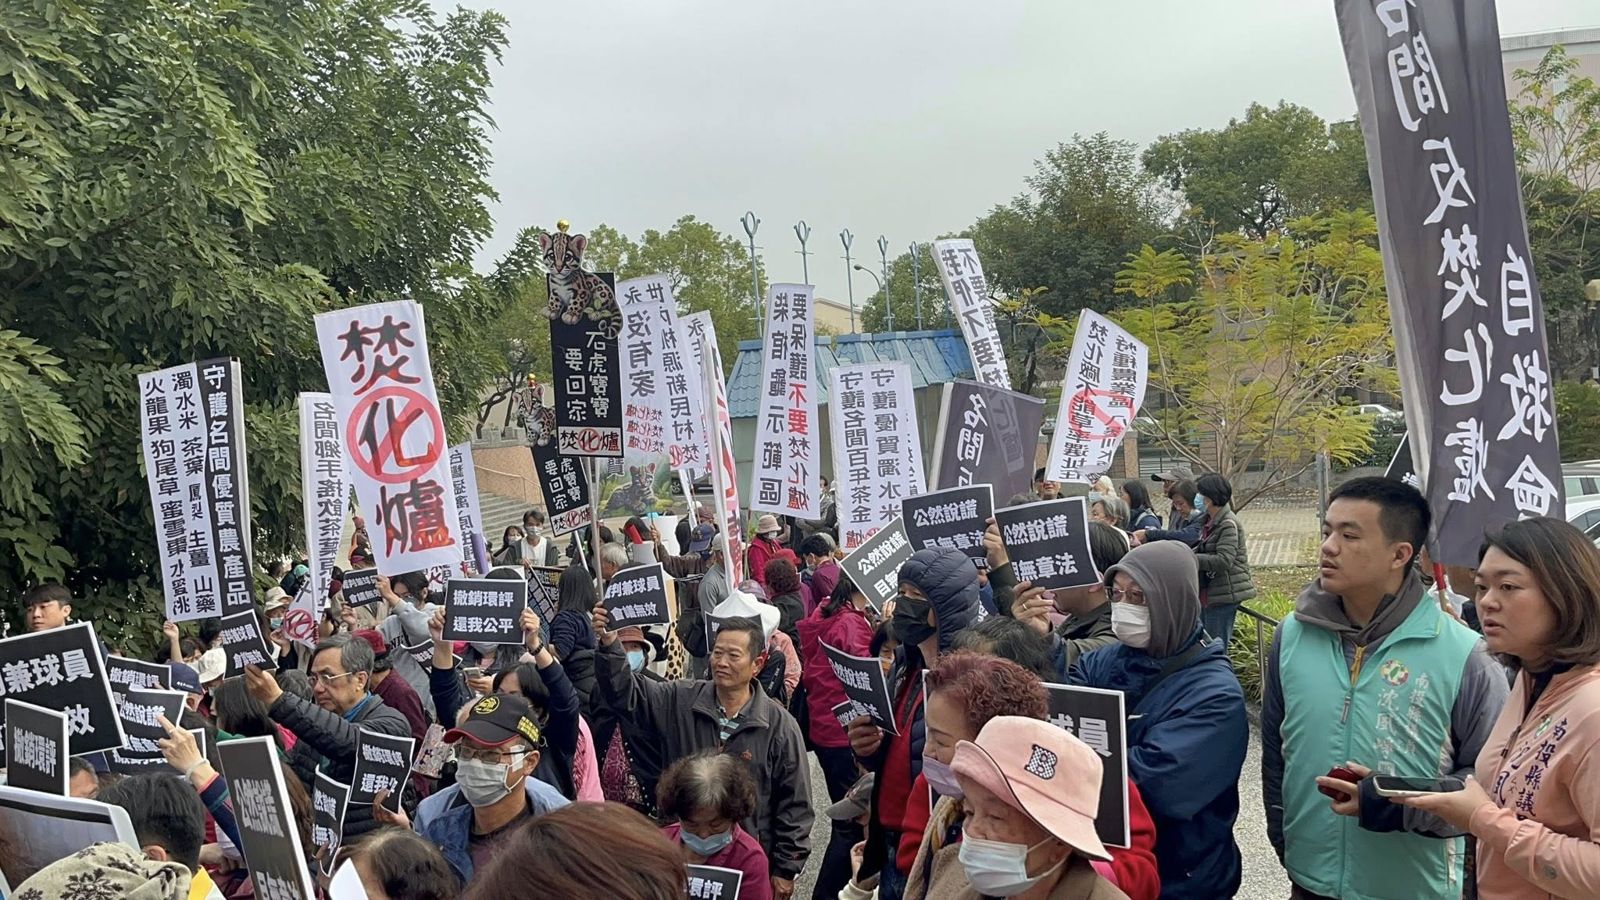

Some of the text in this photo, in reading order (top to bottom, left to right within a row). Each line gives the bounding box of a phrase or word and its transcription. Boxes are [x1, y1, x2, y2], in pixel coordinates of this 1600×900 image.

[565, 348, 587, 422] 要回家
[586, 331, 610, 418] 石虎寶寶
[145, 377, 171, 435] 火龍果
[337, 315, 455, 557] 焚化爐
[560, 429, 621, 452] 焚化爐
[151, 440, 180, 497] 狗尾草
[202, 365, 250, 606] 守護名間優質農產品
[545, 459, 568, 510] 要回家
[913, 499, 978, 527] 公然說謊
[1003, 514, 1069, 546] 公然說謊
[857, 530, 907, 576] 公然說謊
[453, 588, 515, 607] 撤銷環評
[610, 601, 658, 621] 會議無效
[453, 615, 514, 633] 還我公平
[1024, 744, 1058, 780] B
